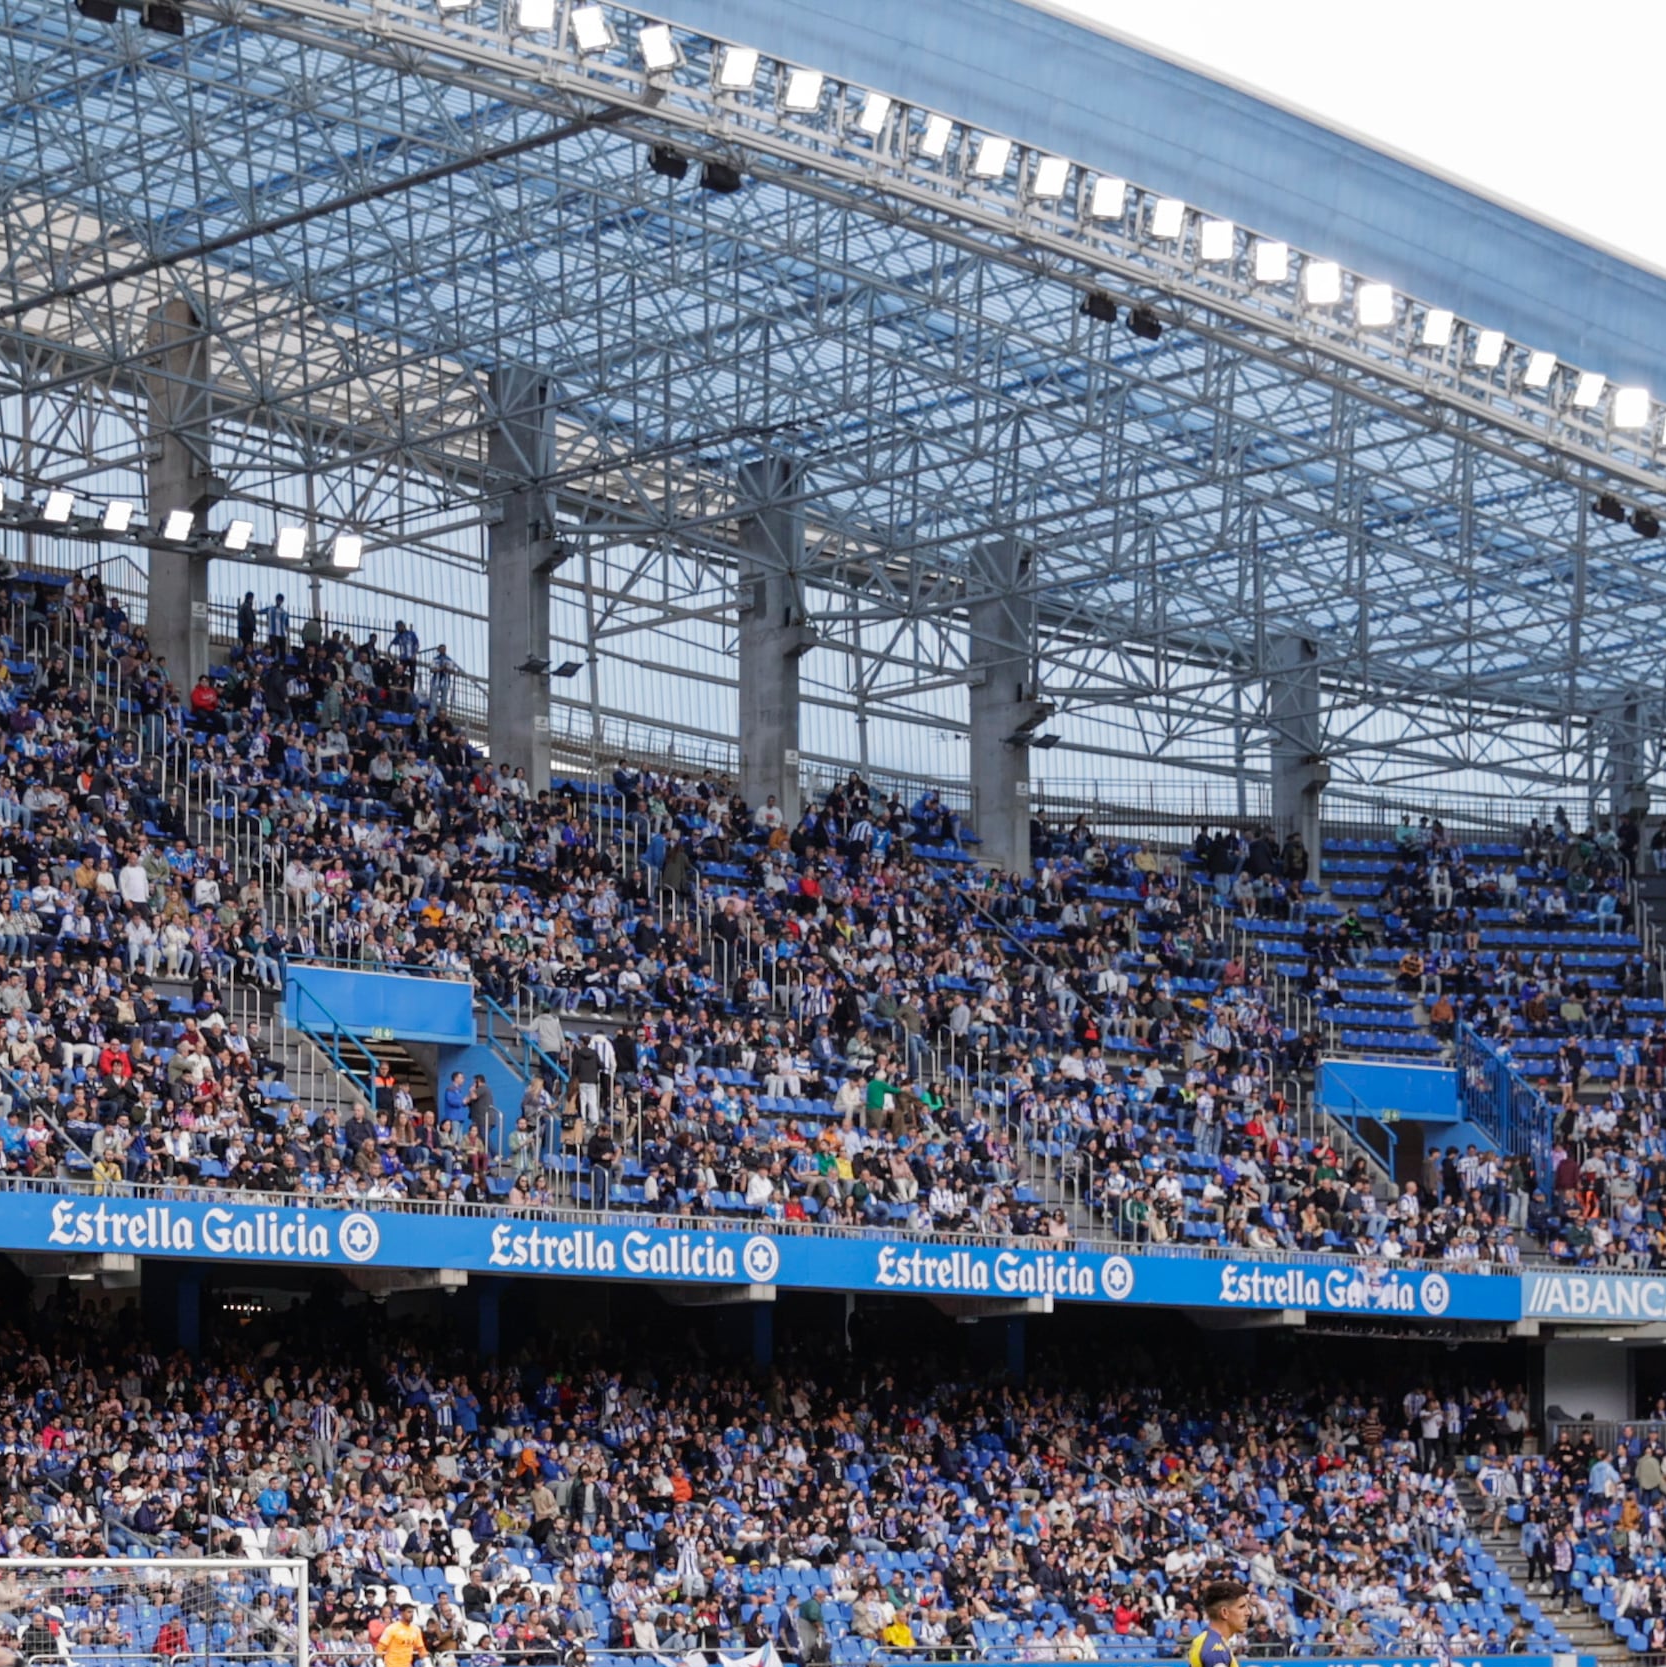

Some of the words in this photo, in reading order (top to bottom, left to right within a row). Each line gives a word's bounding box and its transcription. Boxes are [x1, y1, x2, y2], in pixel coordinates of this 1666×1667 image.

[48, 1199, 196, 1254] Estrella
[202, 1208, 331, 1260] Galicia
[489, 1223, 616, 1274] Estrella
[622, 1230, 735, 1279] Galicia
[875, 1244, 988, 1291] Estrella
[994, 1250, 1094, 1298] Galicia
[1219, 1264, 1321, 1306] Estrella
